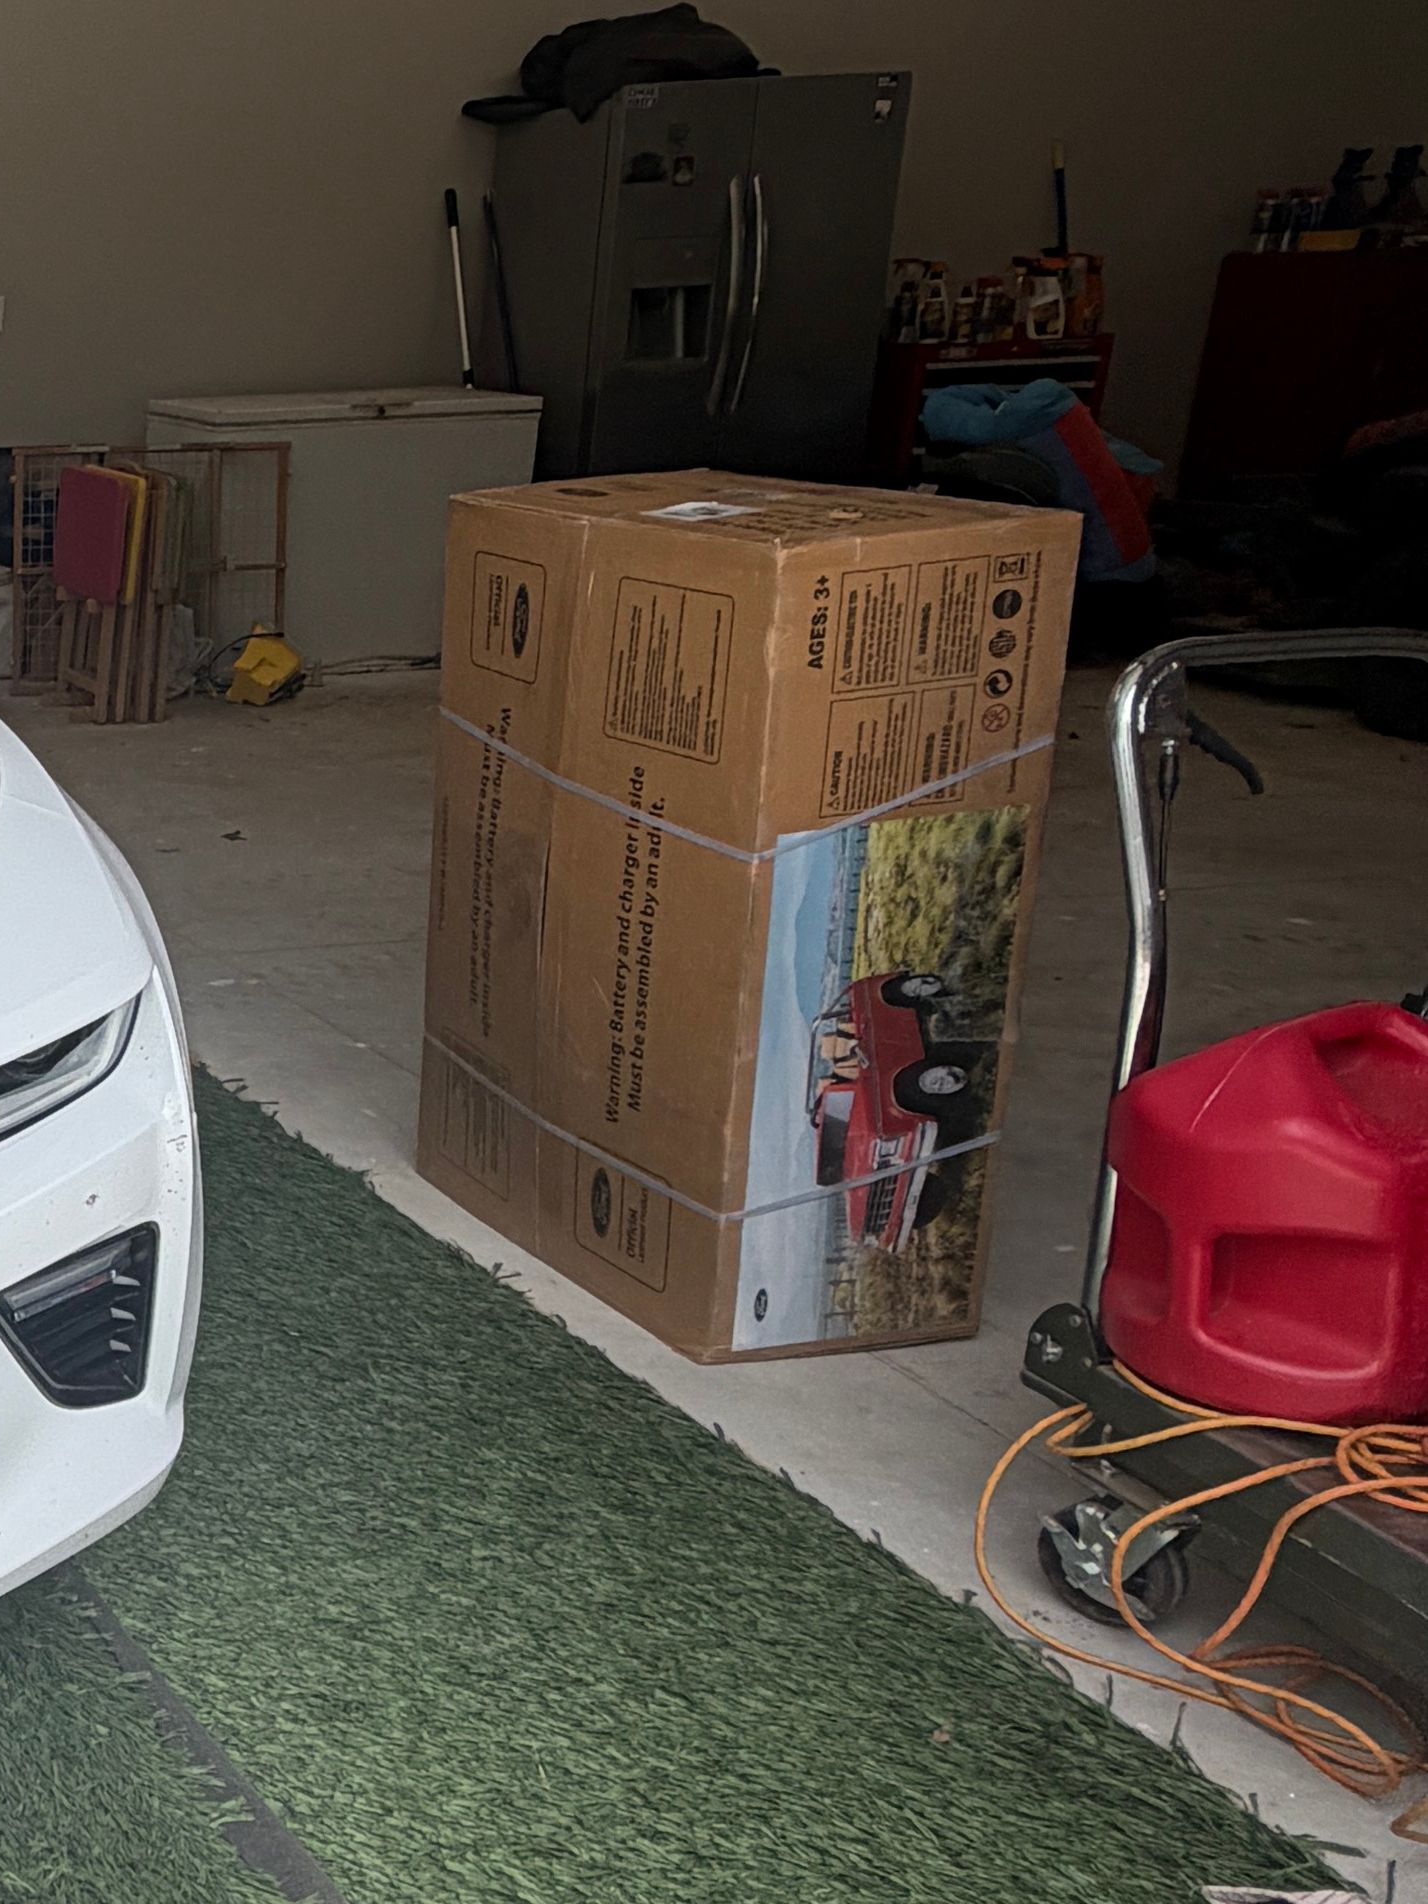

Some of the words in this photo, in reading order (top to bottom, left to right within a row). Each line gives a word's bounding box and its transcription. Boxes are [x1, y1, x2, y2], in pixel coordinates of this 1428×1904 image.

[813, 574, 831, 600] 3+
[807, 606, 828, 670] AGES:
[478, 775, 490, 799] be
[486, 797, 502, 866] Battery
[618, 833, 640, 914] charger
[646, 863, 659, 889] an
[639, 892, 659, 918] by
[616, 916, 631, 956] and
[609, 958, 631, 1033] Battery
[634, 921, 653, 1031] assembled
[629, 1034, 645, 1060] be
[605, 1036, 625, 1123] Warning:
[626, 1063, 643, 1113] Must
